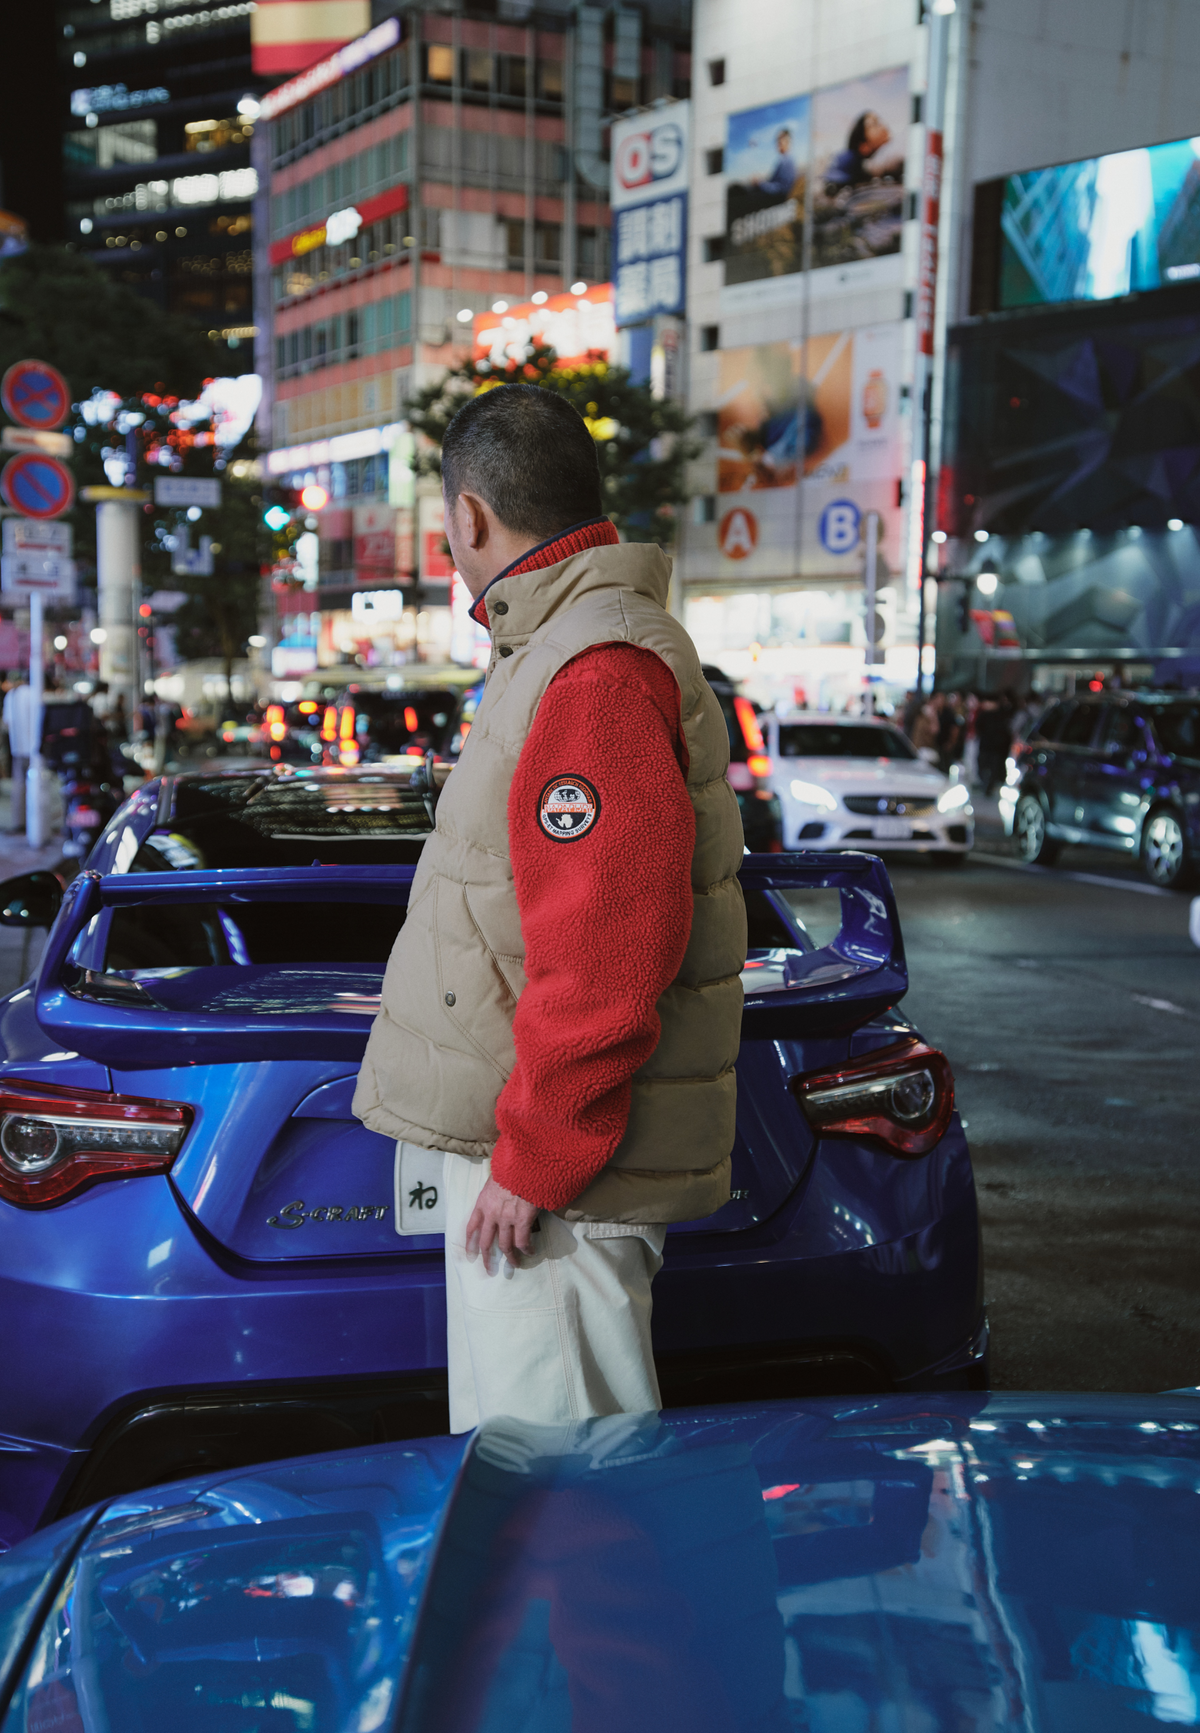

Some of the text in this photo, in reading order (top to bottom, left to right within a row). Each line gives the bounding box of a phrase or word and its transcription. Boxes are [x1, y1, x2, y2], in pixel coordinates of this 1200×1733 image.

[617, 123, 682, 189] OS
[723, 511, 753, 554] A
[827, 505, 858, 550] B
[544, 804, 593, 813] NAPAPIJRI
[575, 814, 592, 833] SURVEYS
[408, 1181, 438, 1210] ね
[266, 1200, 388, 1230] S-CRAFT
